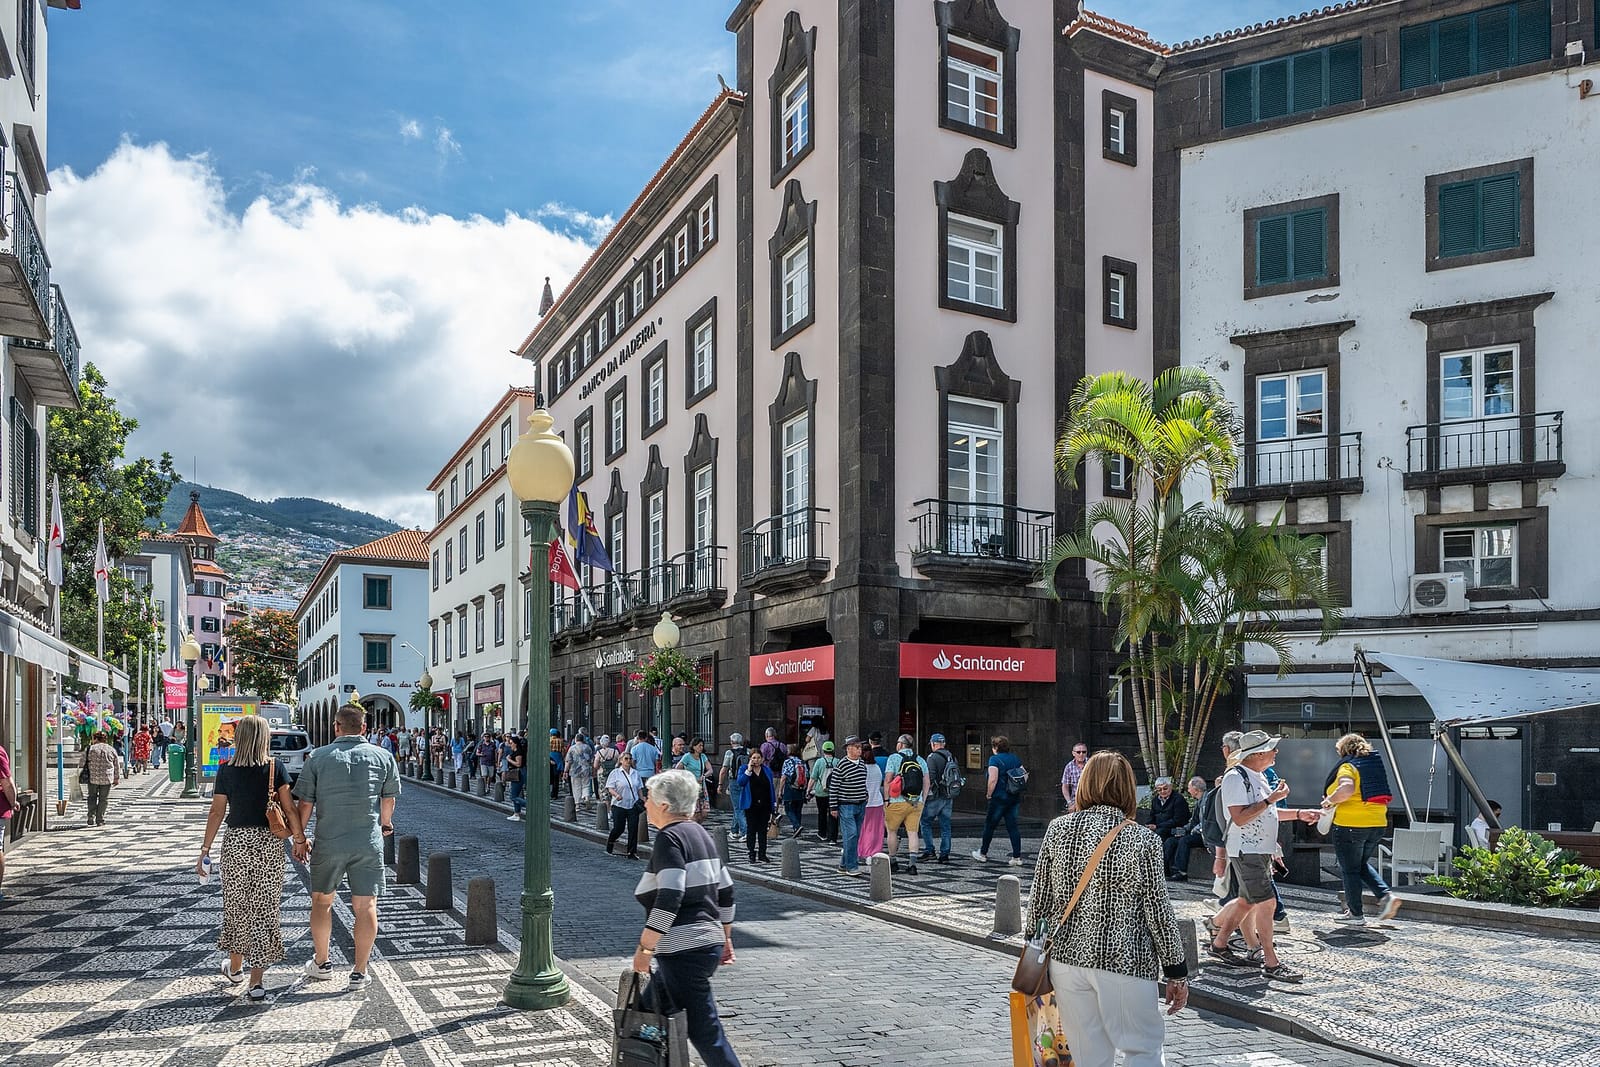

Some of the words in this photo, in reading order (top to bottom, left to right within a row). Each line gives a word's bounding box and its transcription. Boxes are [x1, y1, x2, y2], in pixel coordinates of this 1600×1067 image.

[582, 368, 606, 399] BANCO
[607, 357, 619, 377] DA
[619, 321, 656, 366] MADEIRA
[602, 648, 634, 667] Santander
[774, 657, 816, 675] Santander
[953, 654, 1025, 672] Santander
